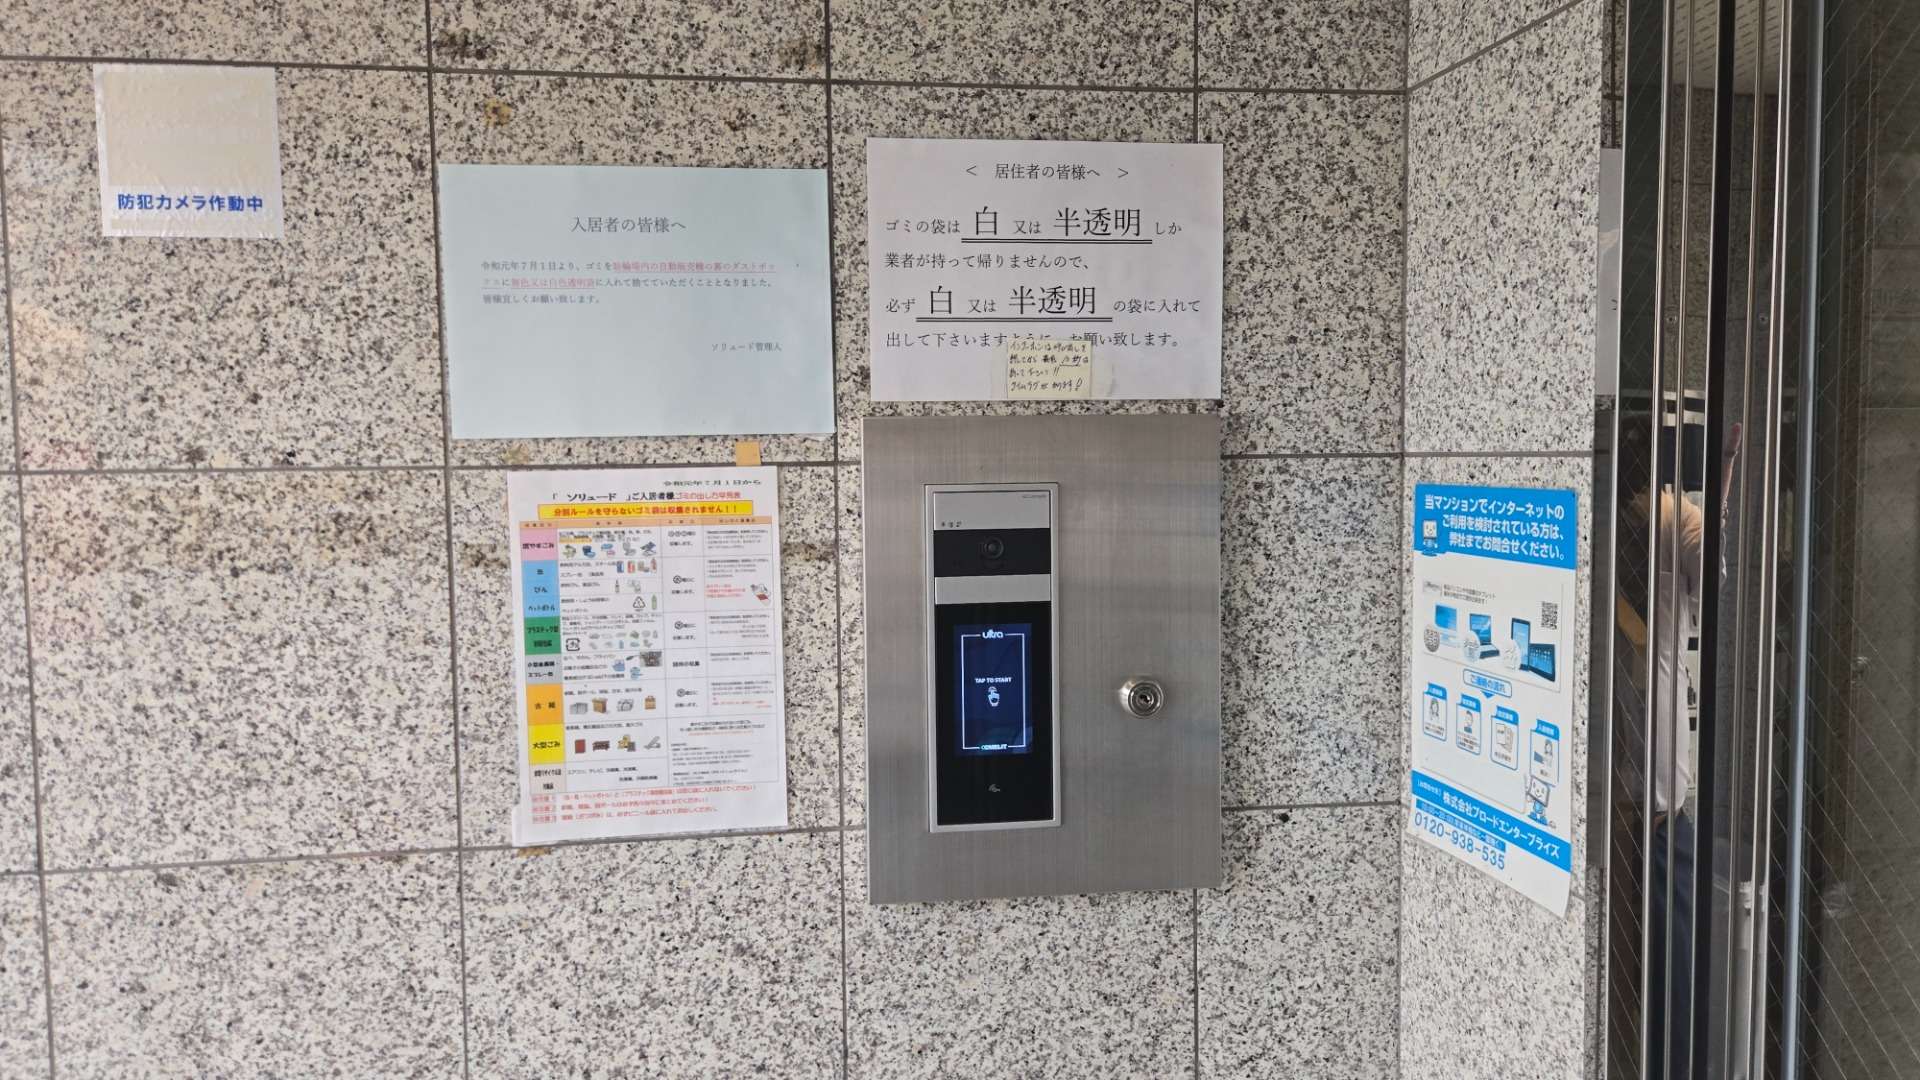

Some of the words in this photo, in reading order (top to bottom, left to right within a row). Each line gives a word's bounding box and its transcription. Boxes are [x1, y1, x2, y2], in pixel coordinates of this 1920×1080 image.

[994, 163, 1100, 180] 居住者の皆様へ
[117, 194, 263, 212] 防犯カメラ作動中
[571, 216, 686, 233] 入居者の皆様へ
[885, 218, 961, 235] ゴミの袋は
[974, 206, 998, 237] 白
[1013, 219, 1041, 235] 又は
[1053, 206, 1141, 237] 半透明
[1154, 222, 1182, 235] しか
[885, 253, 1090, 269] 業者が持って帰りませんので、
[886, 298, 915, 313] 必ず
[929, 285, 952, 315] 白
[968, 298, 996, 314] 又は
[1008, 285, 1096, 315] 半透明
[1113, 298, 1200, 314] の袋に入れて
[1425, 494, 1565, 520] 当マンションでインターネットの
[1442, 513, 1565, 541] ご利用を検討されている方は、
[1449, 531, 1565, 561] 弊社までお問合せください。
[1443, 790, 1560, 859] 株式会社ブロードエンタープライズ
[1414, 811, 1505, 870] 0120-938-535
